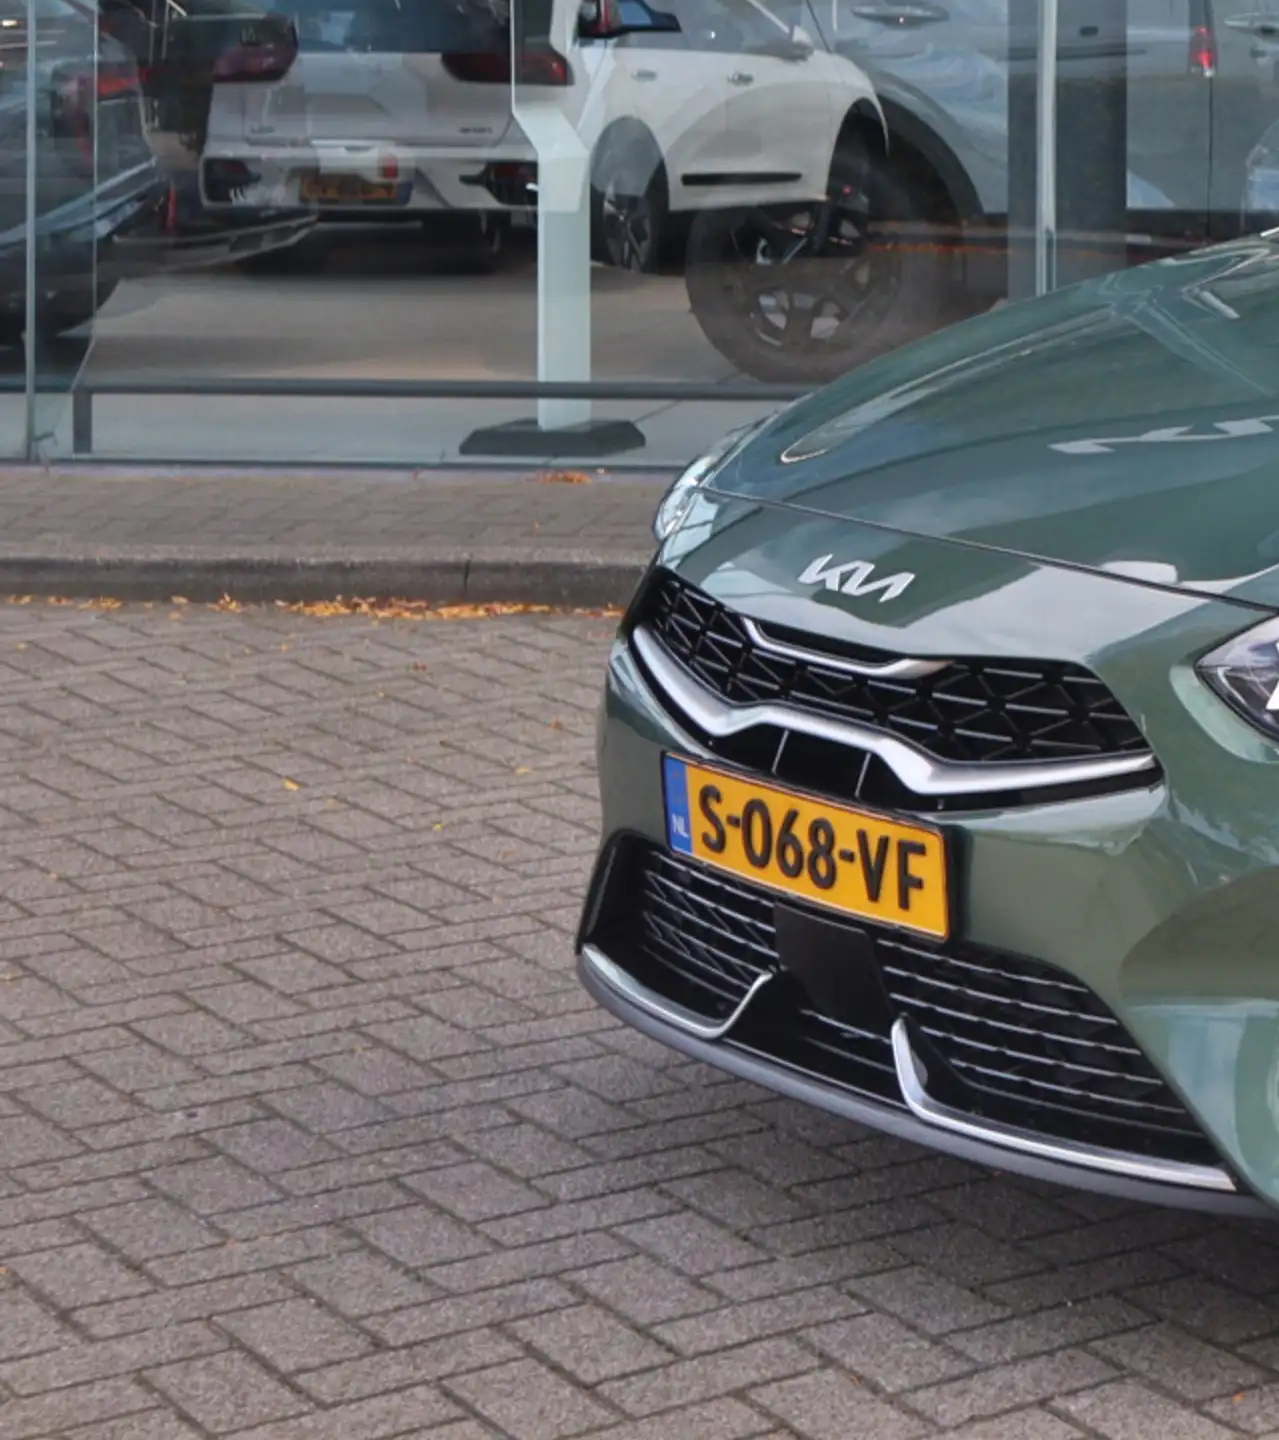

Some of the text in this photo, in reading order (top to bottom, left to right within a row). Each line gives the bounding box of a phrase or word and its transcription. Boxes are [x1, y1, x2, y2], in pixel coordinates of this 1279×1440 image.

[798, 552, 917, 605] KIA
[672, 812, 690, 840] NL
[698, 783, 927, 911] S-068-VF
